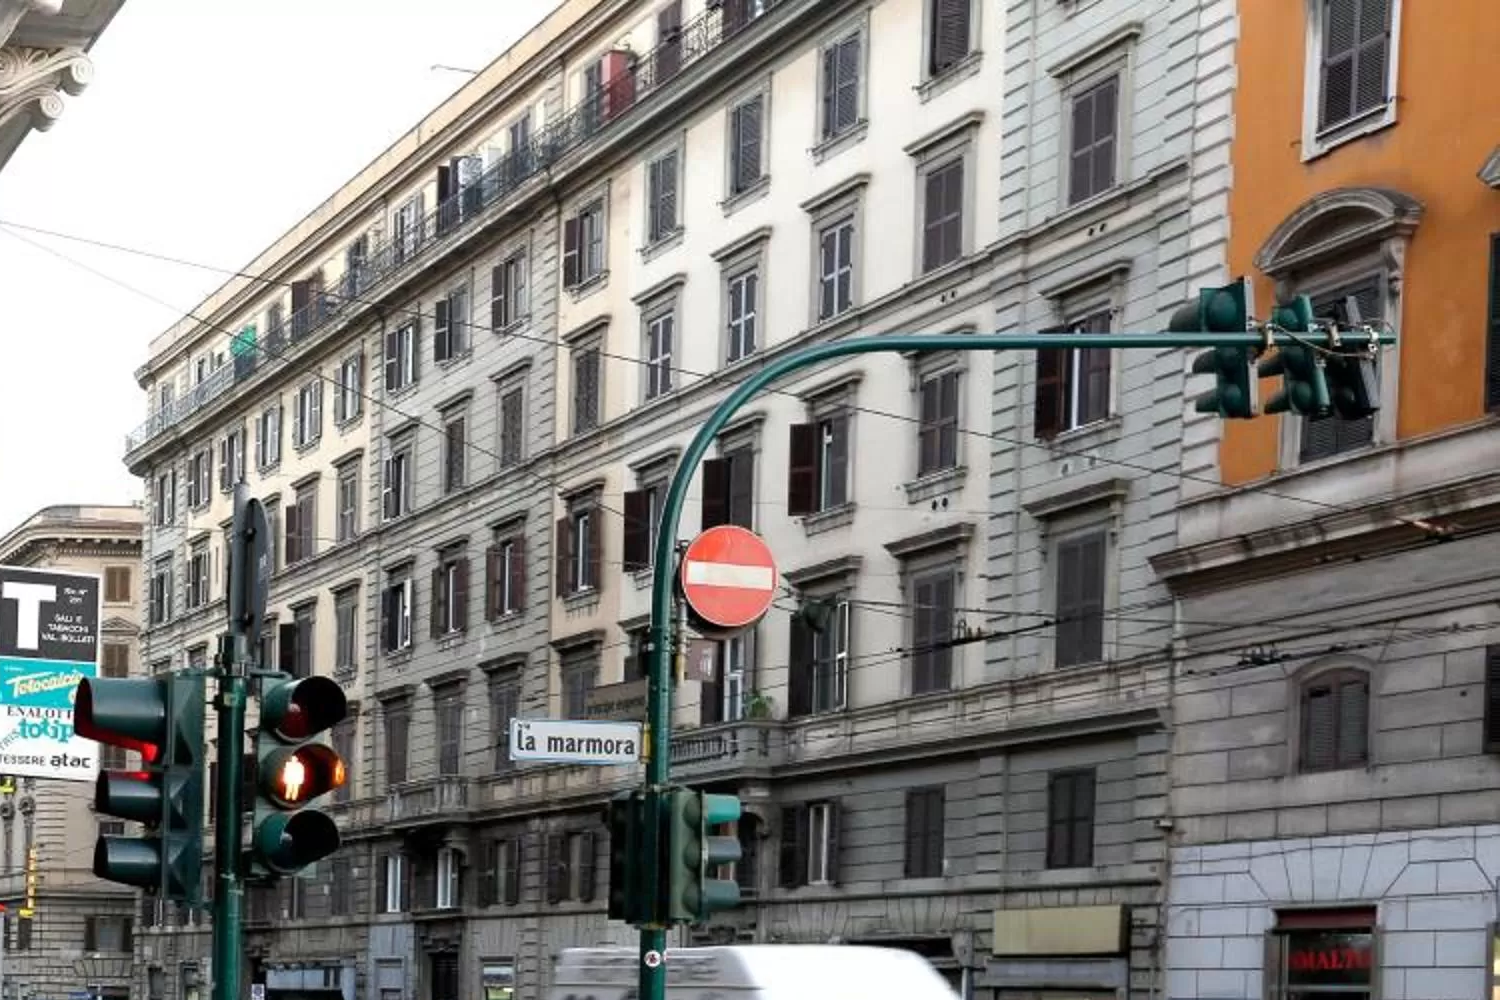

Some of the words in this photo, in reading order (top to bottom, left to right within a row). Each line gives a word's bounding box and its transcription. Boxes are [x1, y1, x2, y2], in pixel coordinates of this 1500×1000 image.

[2, 581, 57, 650] T
[7, 705, 74, 720] ENALOTT
[18, 718, 74, 743] totip
[547, 734, 635, 755] marmora
[50, 752, 91, 769] atac
